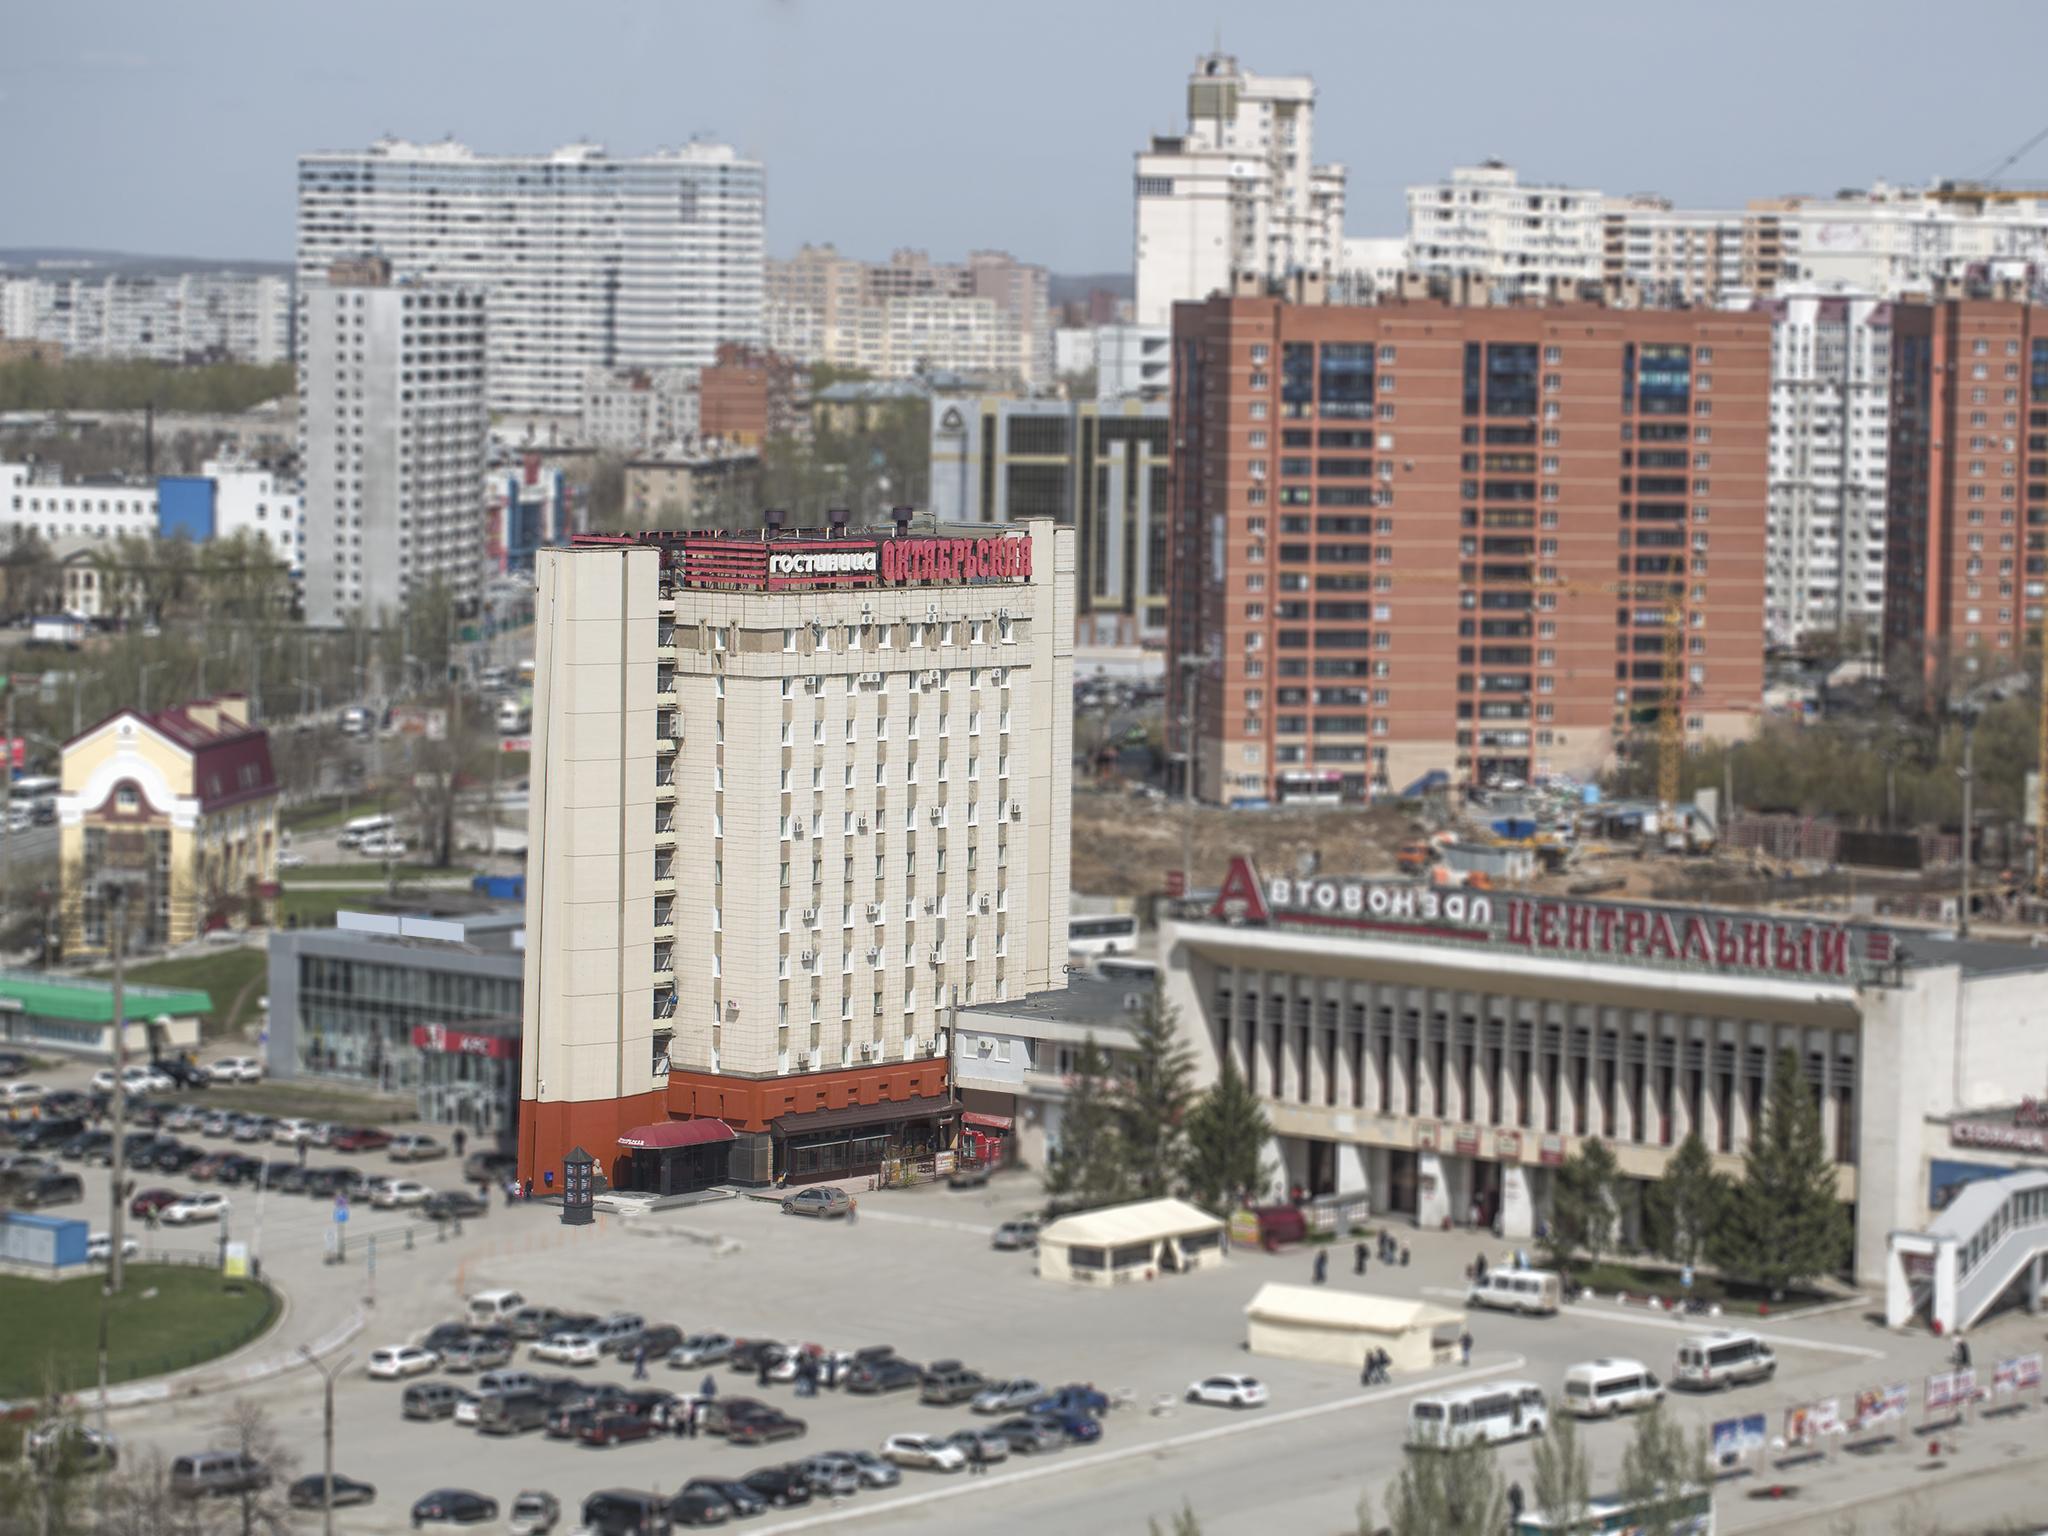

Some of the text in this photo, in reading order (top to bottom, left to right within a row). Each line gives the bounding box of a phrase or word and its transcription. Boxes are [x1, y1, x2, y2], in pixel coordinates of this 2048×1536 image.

[882, 537, 1032, 580] ОКТЯБРЬСКАЯ
[1208, 856, 1849, 975] Автовокзал ЦЕНТРАЛЬНЫЙ
